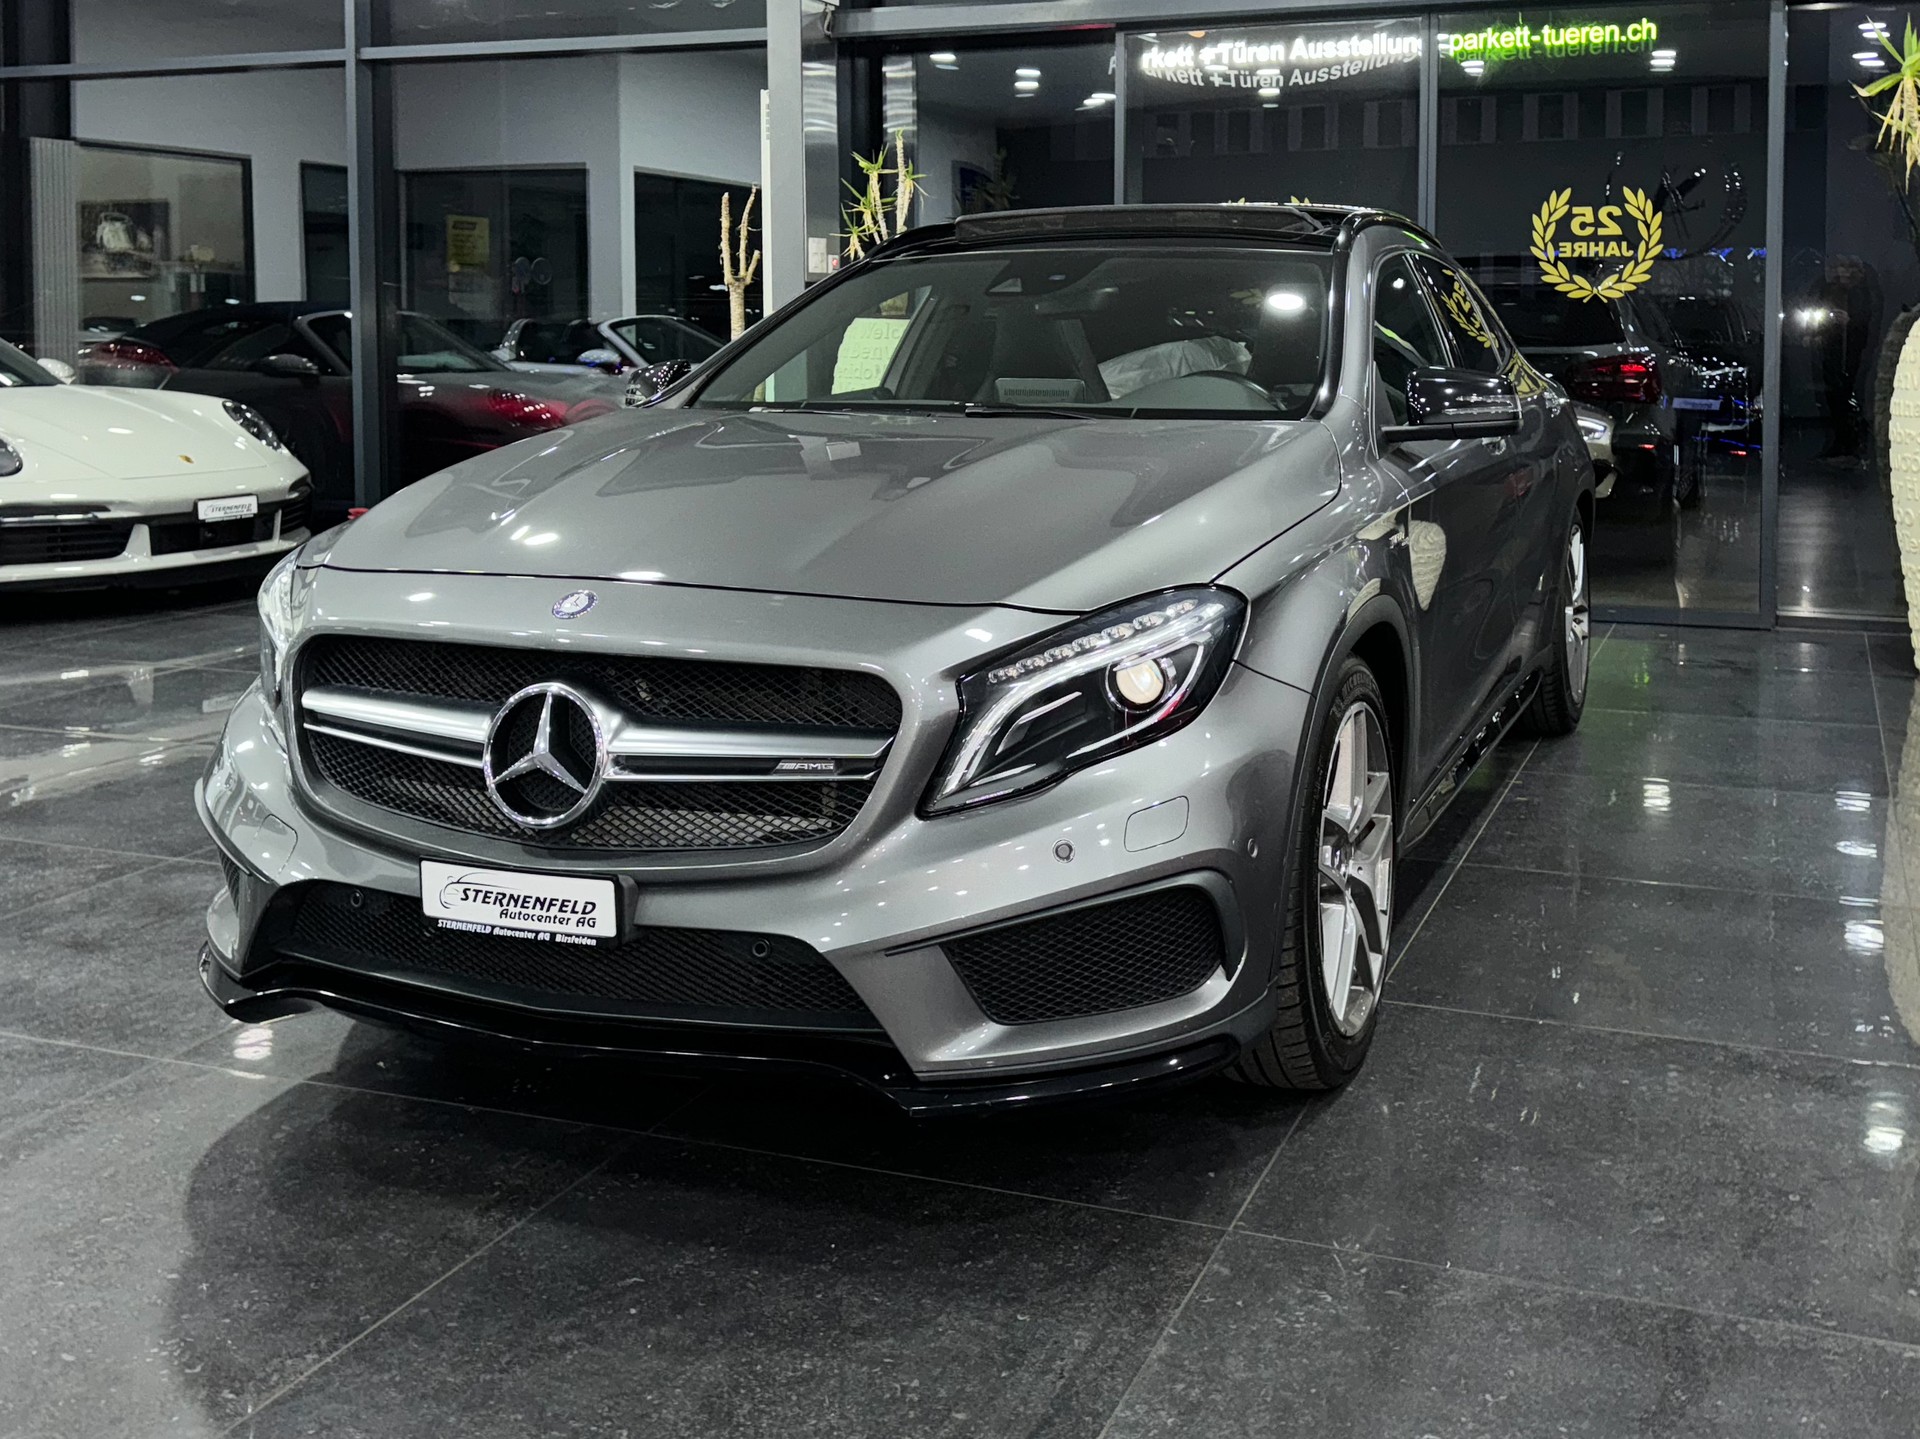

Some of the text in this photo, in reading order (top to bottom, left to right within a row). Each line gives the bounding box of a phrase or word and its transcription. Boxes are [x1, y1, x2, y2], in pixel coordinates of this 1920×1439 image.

[1449, 17, 1657, 57] parkett-tueren.ch
[1217, 41, 1285, 64] Türen
[1225, 69, 1284, 88] Türen
[794, 762, 834, 770] AMG
[460, 888, 597, 915] STERNENFELD
[499, 908, 597, 928] Autocenter AG
[437, 919, 597, 947] STERNENFELD Autocenter AG Birsfelden
